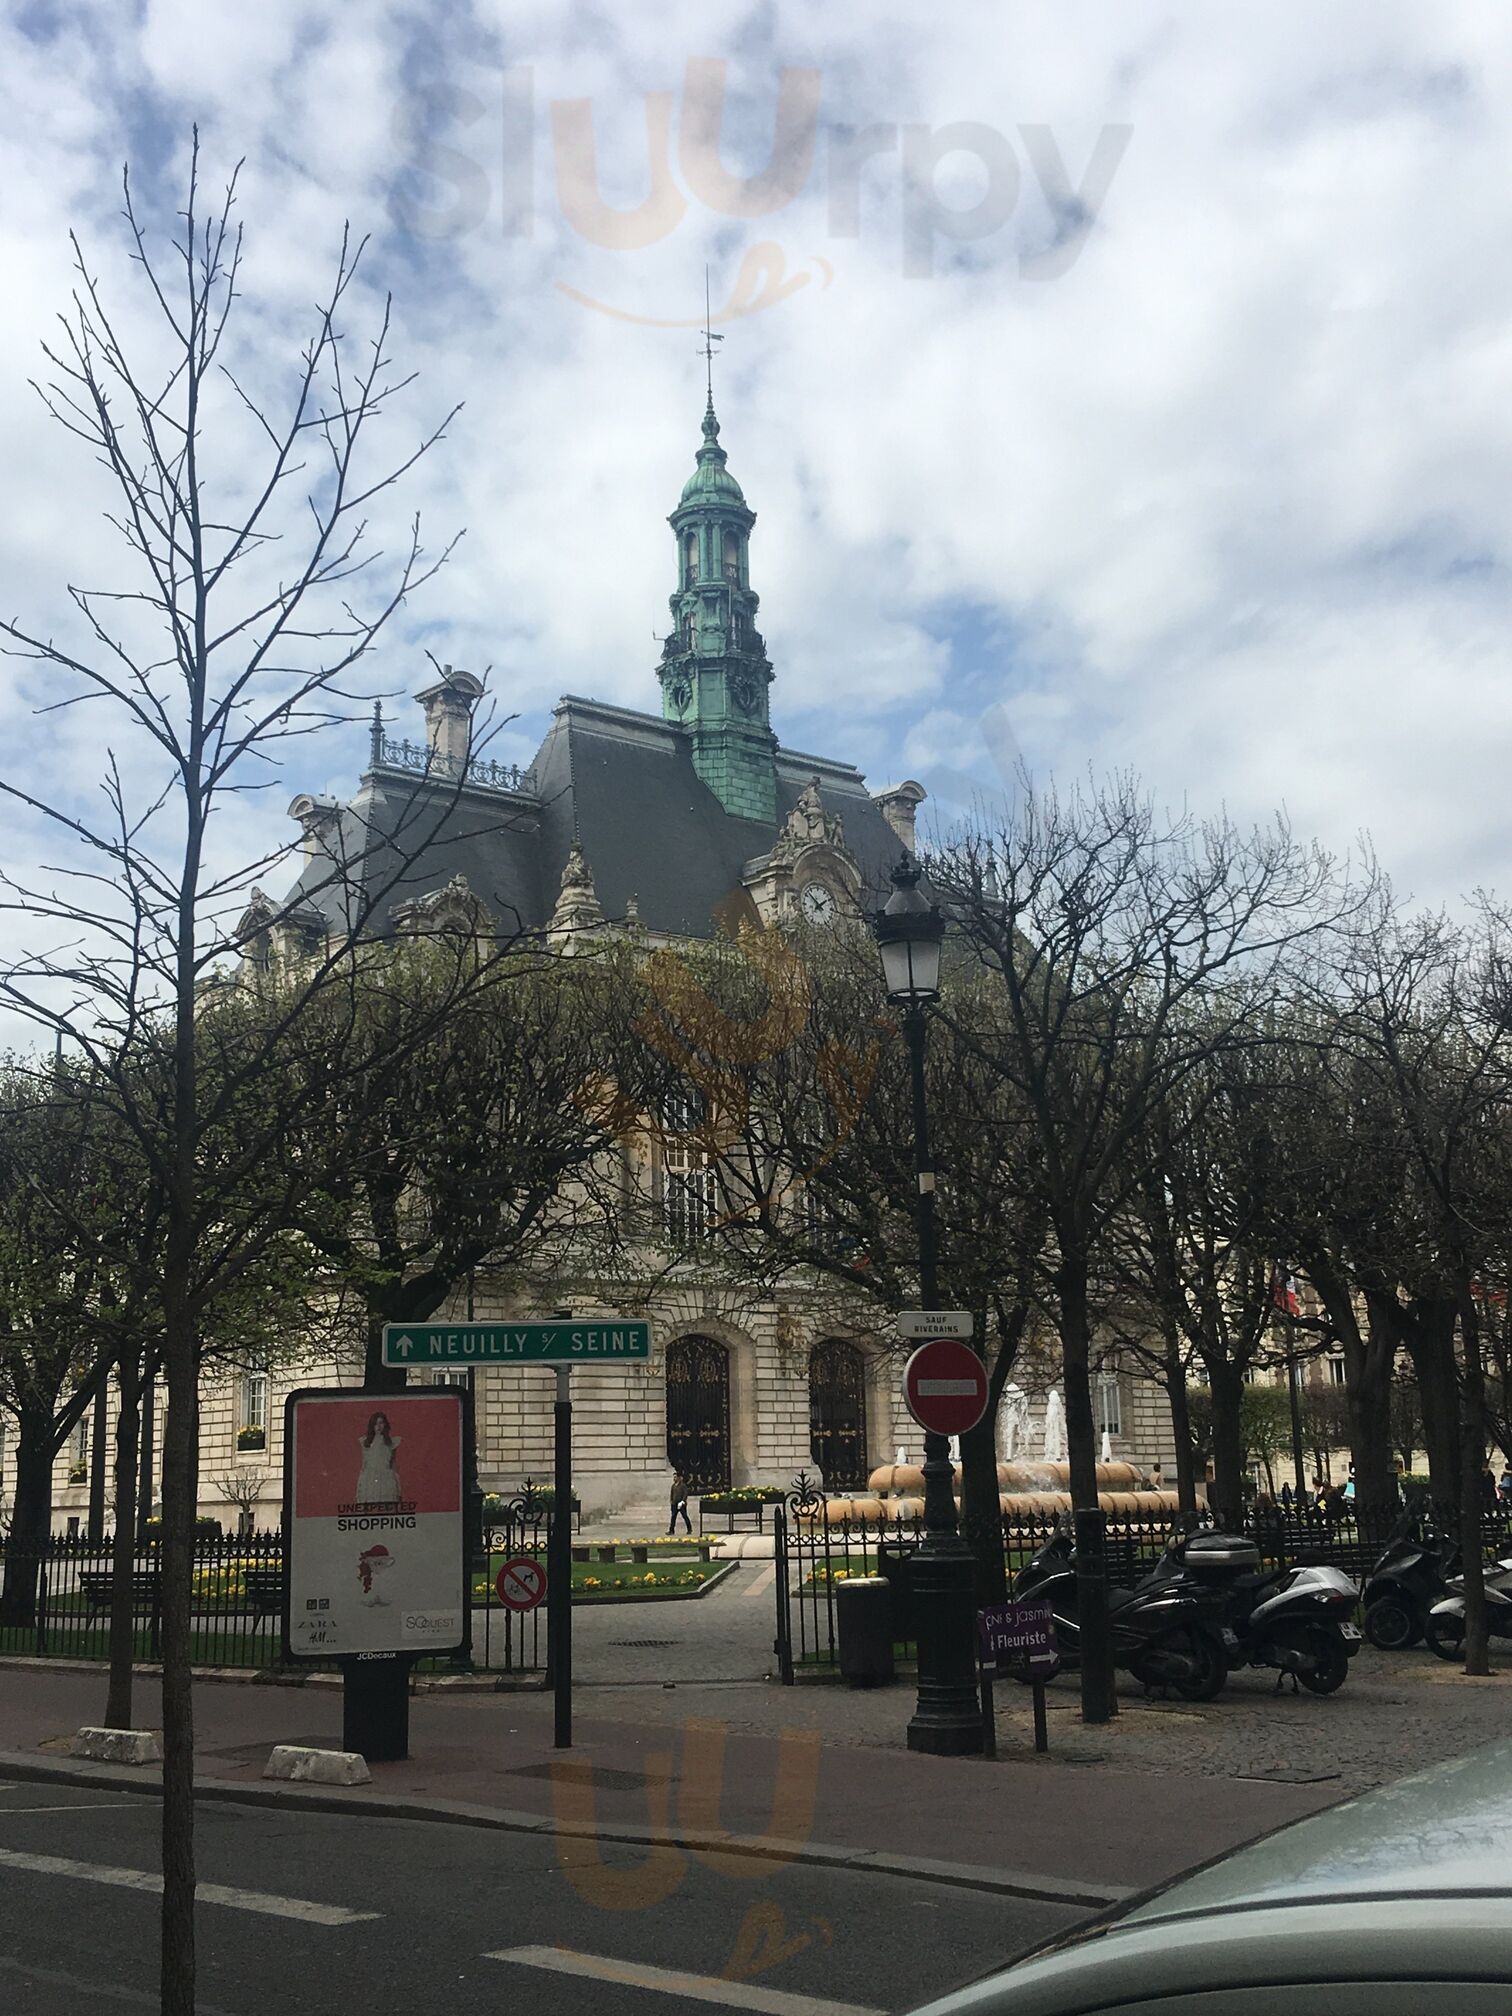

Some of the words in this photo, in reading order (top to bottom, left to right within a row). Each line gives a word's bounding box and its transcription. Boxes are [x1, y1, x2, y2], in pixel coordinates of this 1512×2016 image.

[914, 1325, 959, 1333] RIVERAINS
[429, 1333, 527, 1355] NEUILLY
[571, 1331, 641, 1351] SEINE
[337, 1501, 417, 1513] UNEXPECTED
[337, 1516, 416, 1531] SHOPPING
[997, 1631, 1047, 1649] Fleuriste
[356, 1652, 397, 1661] JCDecaux
